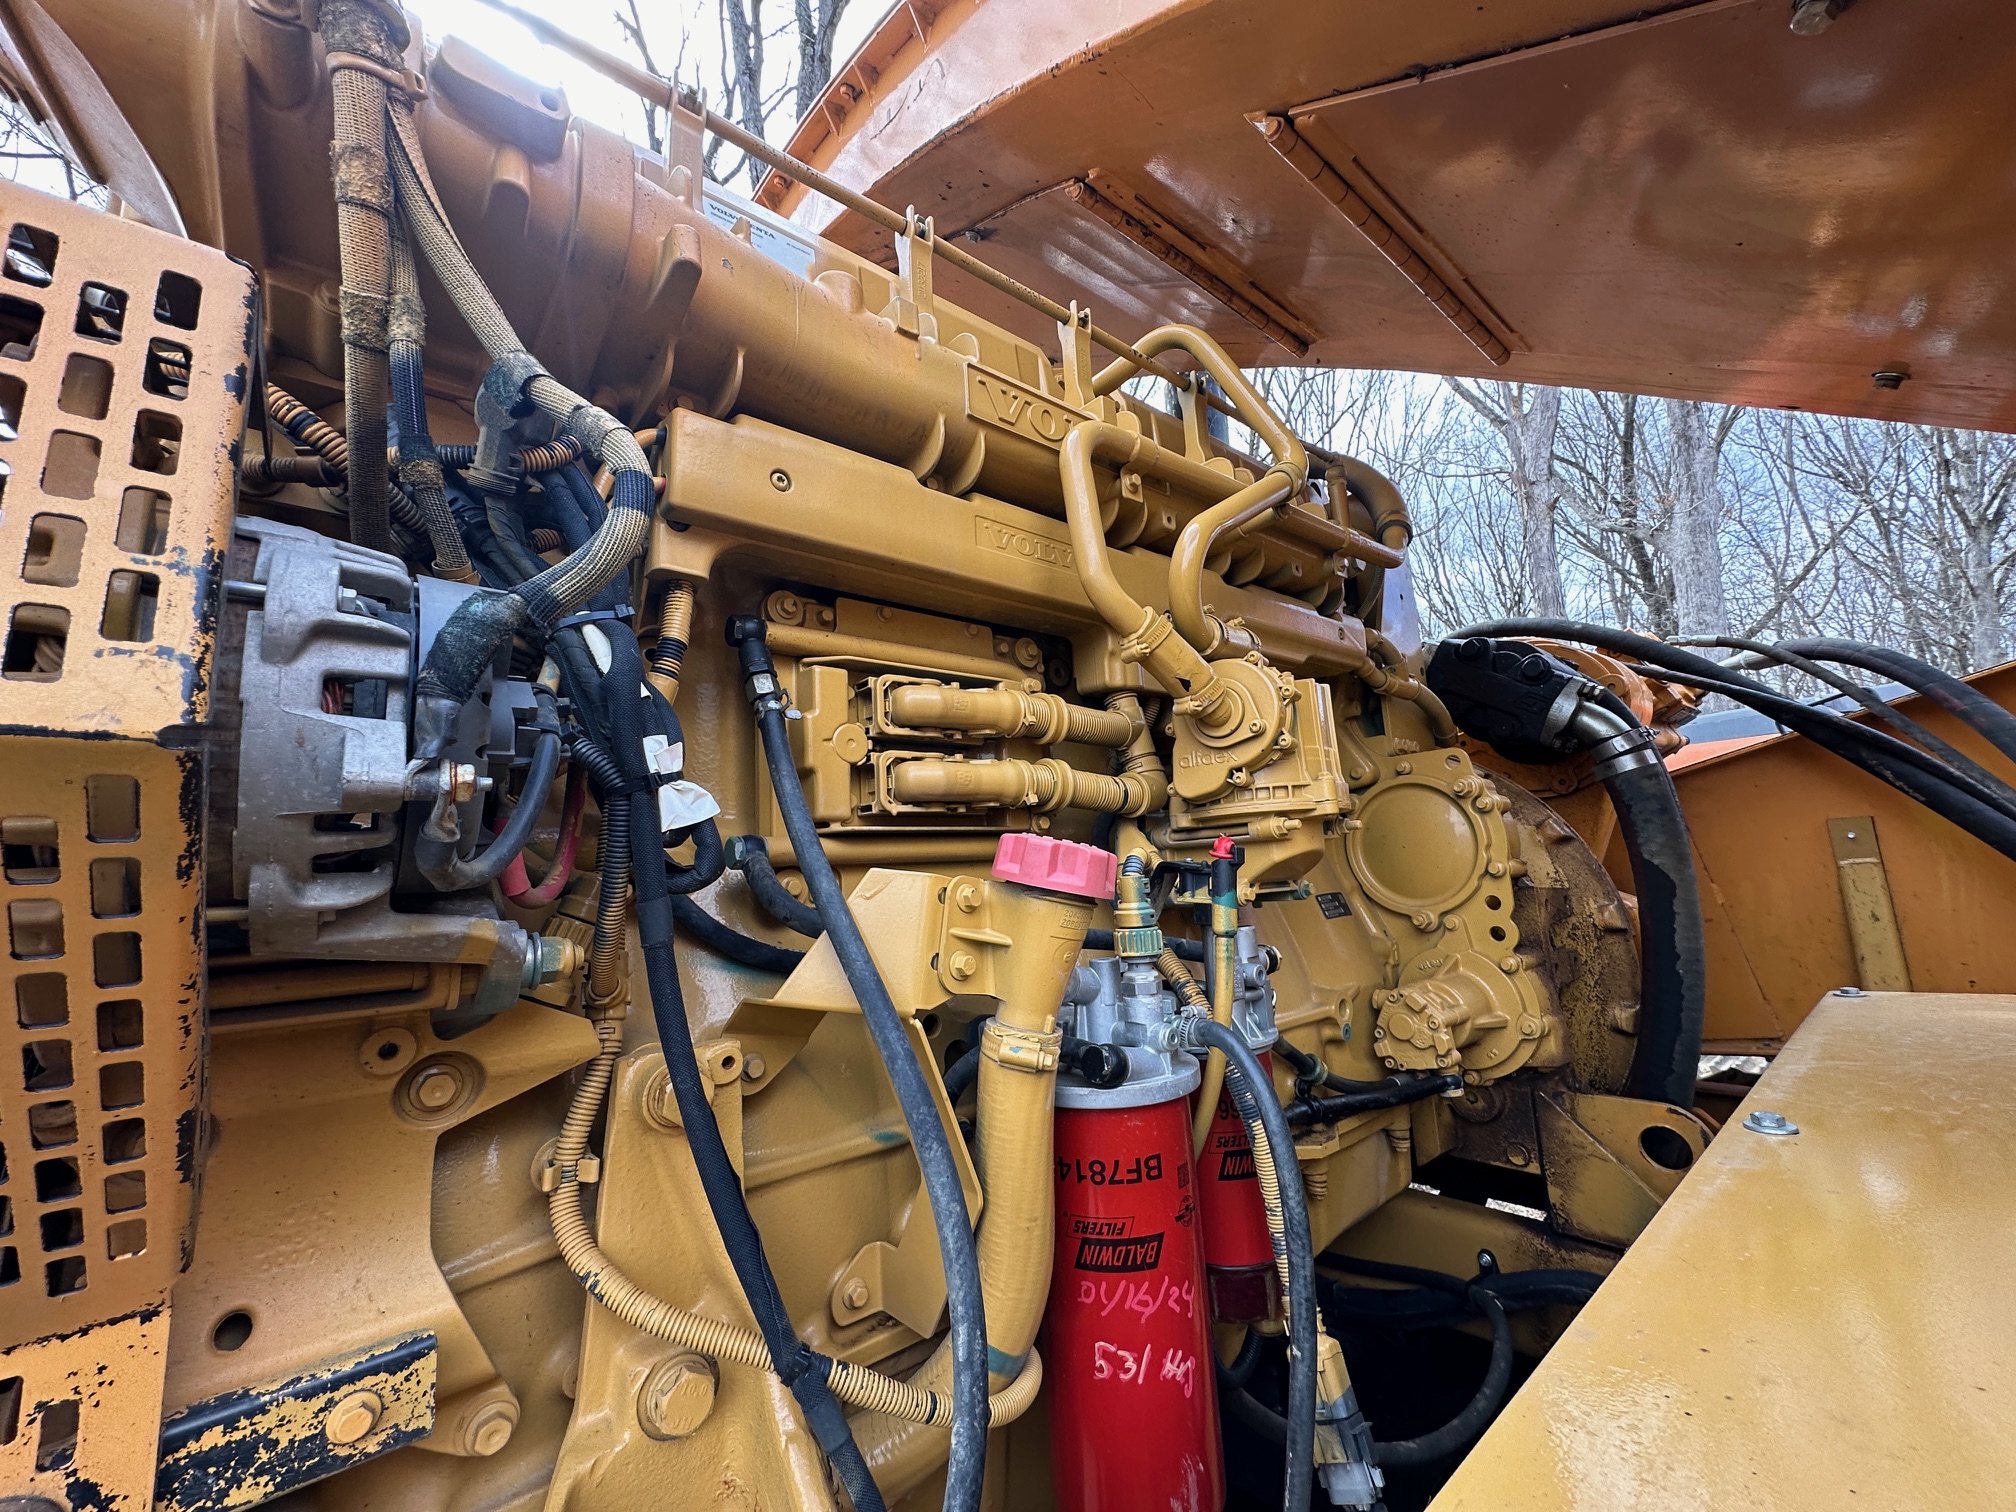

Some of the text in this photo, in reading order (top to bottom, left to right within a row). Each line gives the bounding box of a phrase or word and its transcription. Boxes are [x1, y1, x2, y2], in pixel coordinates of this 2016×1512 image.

[709, 203, 738, 220] VOLV
[750, 224, 776, 240] ENTA
[984, 522, 1075, 568] VOLV
[1218, 1100, 1241, 1120] 66
[1216, 1135, 1250, 1148] LTERS
[1057, 1153, 1163, 1185] BF7814
[1073, 1220, 1126, 1237] FILTERS
[1081, 1241, 1159, 1267] BALDWIN
[1093, 1341, 1152, 1384] 531
